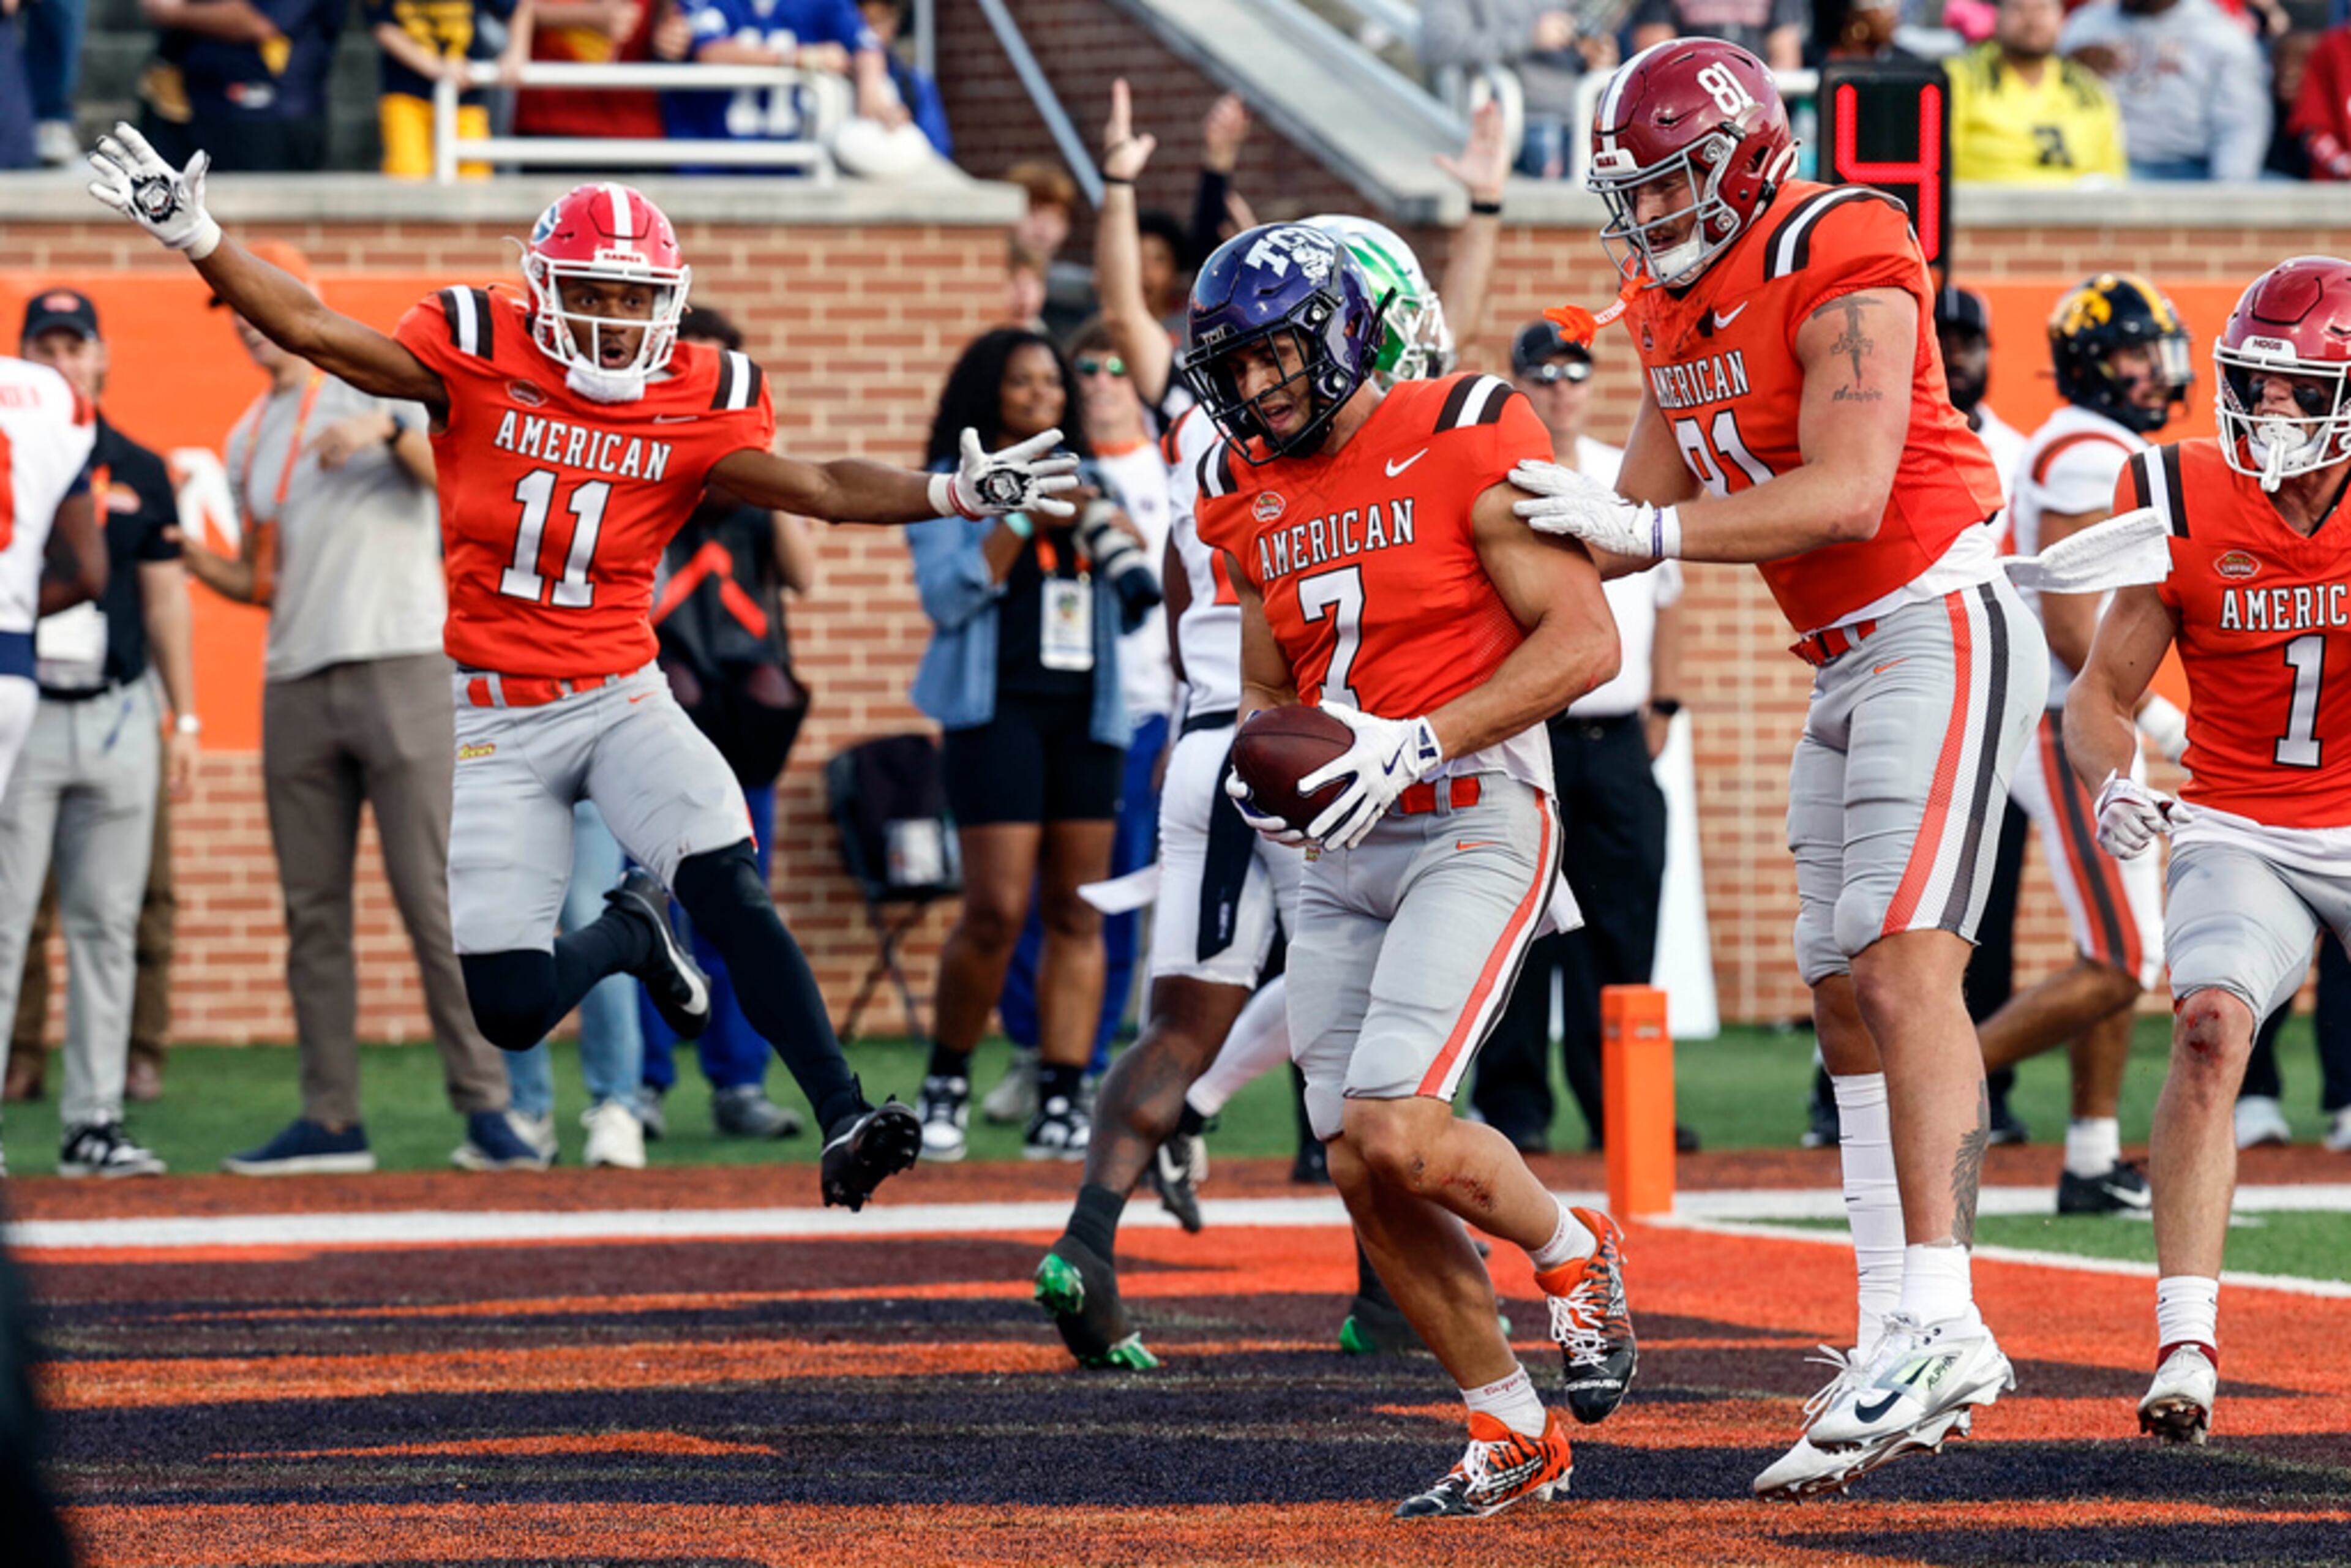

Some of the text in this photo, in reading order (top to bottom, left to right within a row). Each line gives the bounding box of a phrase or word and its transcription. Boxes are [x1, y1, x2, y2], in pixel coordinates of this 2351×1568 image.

[1697, 61, 1754, 116] 81
[1835, 83, 1941, 262] 4
[2252, 338, 2282, 351] HOGS
[493, 408, 672, 482] AMERICAN
[499, 468, 615, 609] 11
[1258, 497, 1415, 582] AMERICAN
[1298, 563, 1367, 713] 7
[2220, 584, 2349, 632] AMERIC
[2273, 634, 2328, 770] 1
